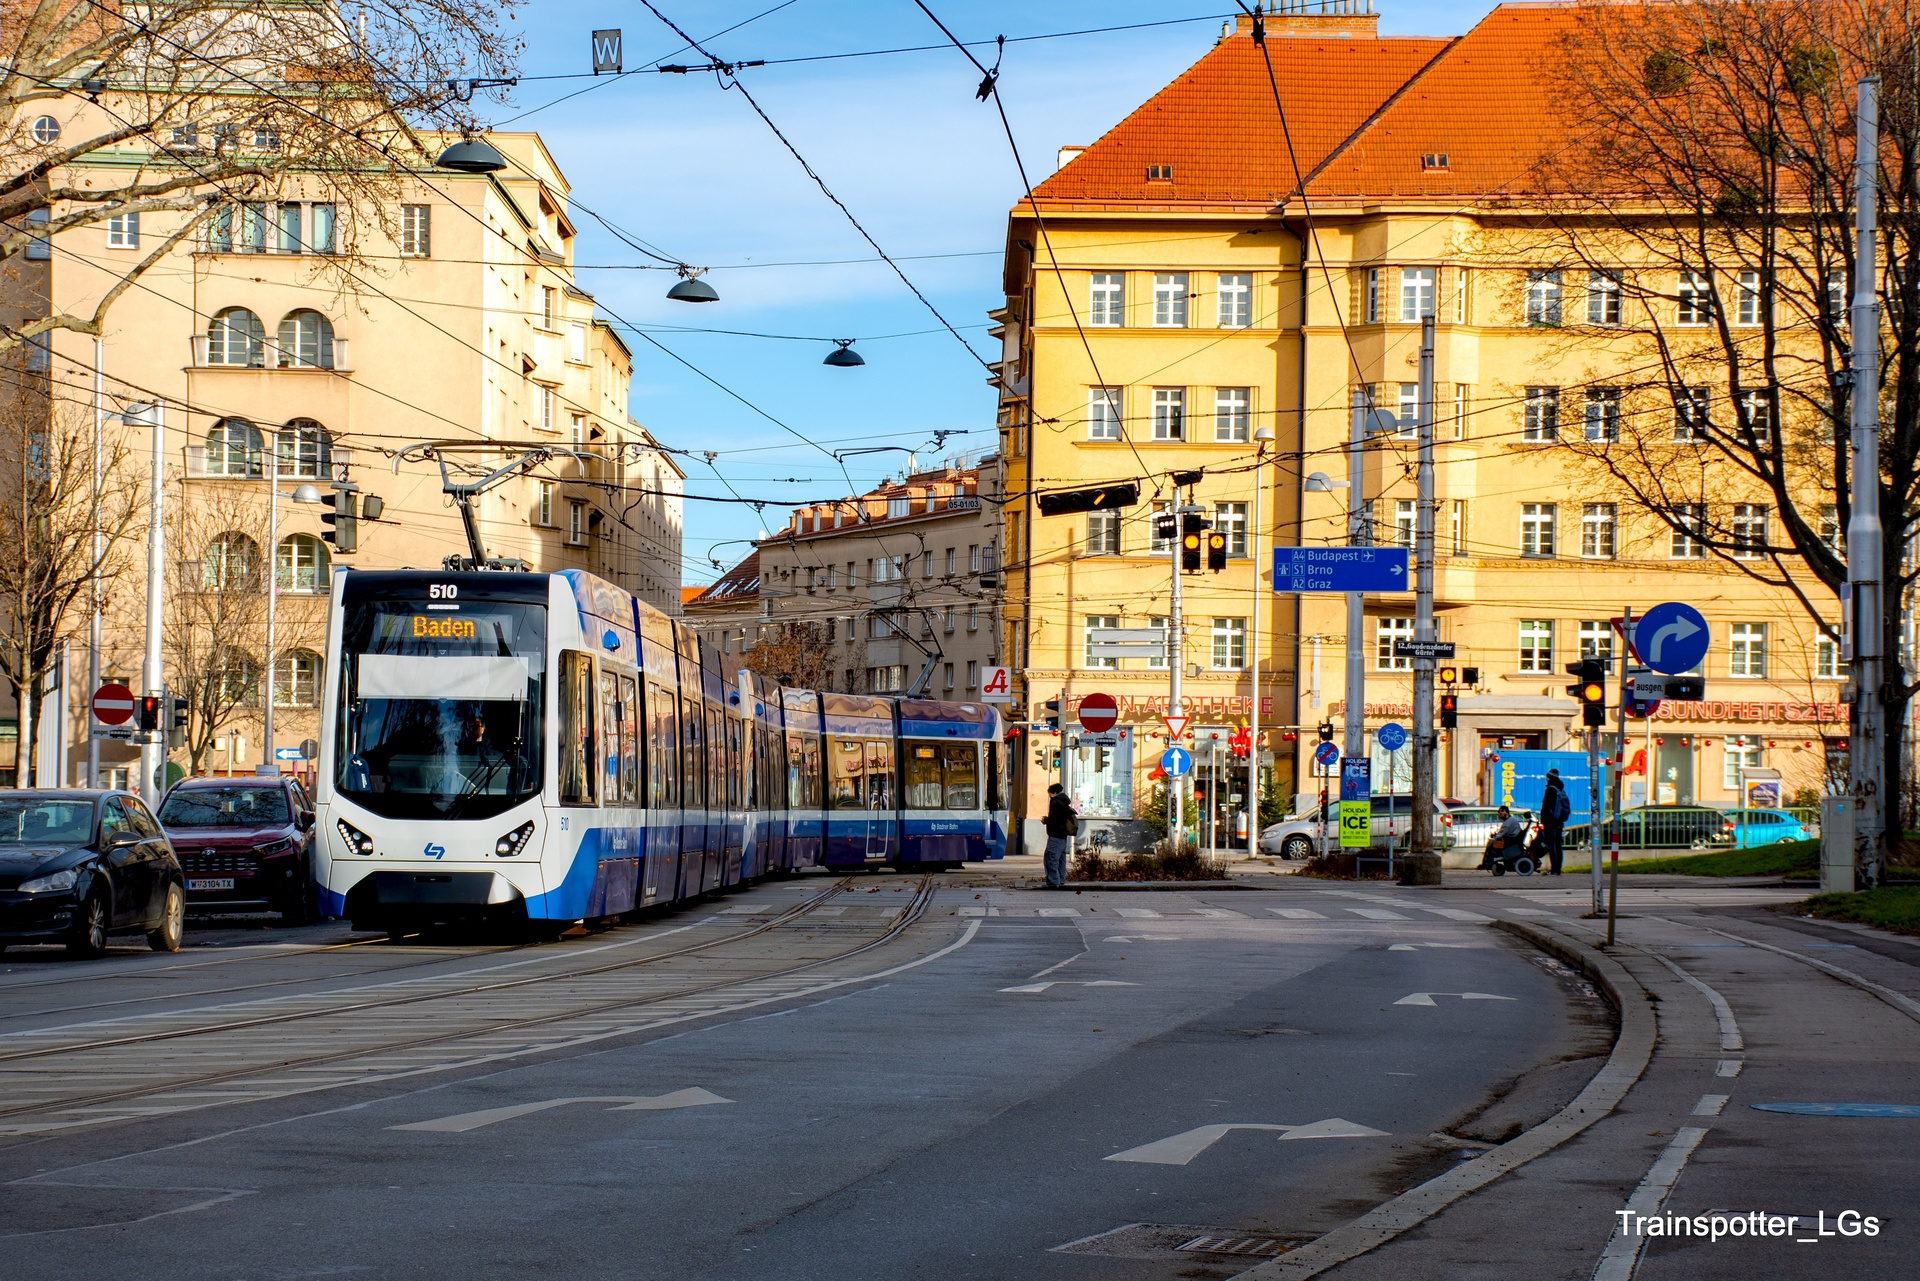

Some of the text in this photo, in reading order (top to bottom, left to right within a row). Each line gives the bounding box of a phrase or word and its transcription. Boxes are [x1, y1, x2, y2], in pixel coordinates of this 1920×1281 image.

[594, 37, 620, 65] W
[949, 500, 979, 509] 05-01/03
[1293, 551, 1359, 563] A4 Budapest
[1293, 564, 1333, 575] S1 Brno
[1293, 578, 1332, 589] A2 Graz
[429, 584, 458, 599] 510
[413, 616, 475, 637] Baden
[1636, 683, 1664, 693] ausgen.
[1345, 765, 1368, 778] ICE
[1343, 816, 1368, 830] ICE
[202, 880, 221, 888] 3104
[222, 880, 232, 888] TX
